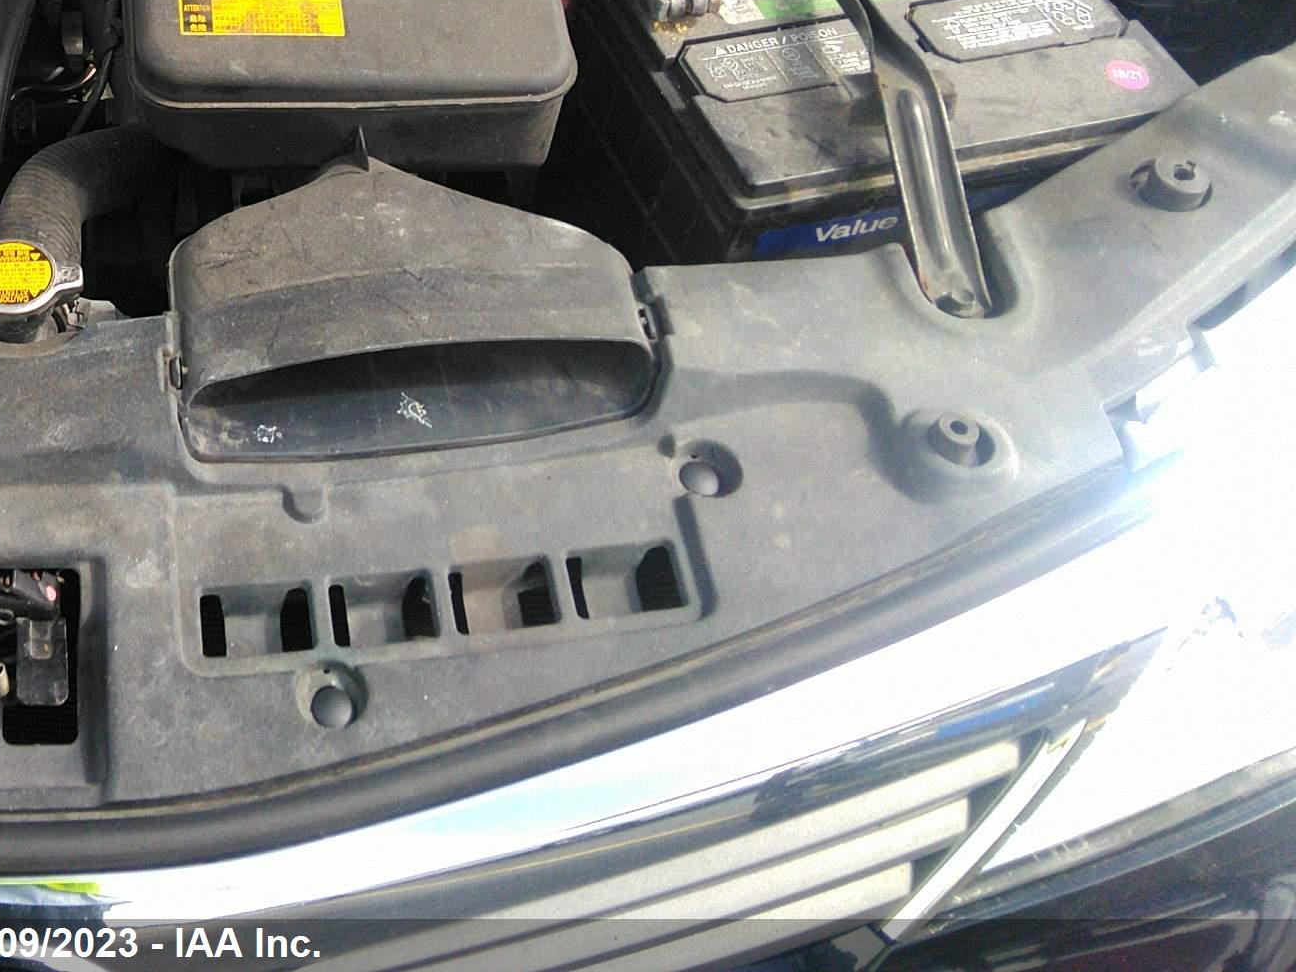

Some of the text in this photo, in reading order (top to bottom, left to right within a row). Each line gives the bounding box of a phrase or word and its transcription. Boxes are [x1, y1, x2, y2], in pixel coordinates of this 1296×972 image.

[725, 37, 779, 55] DANGER
[789, 27, 838, 43] POISON
[815, 216, 898, 243] Value
